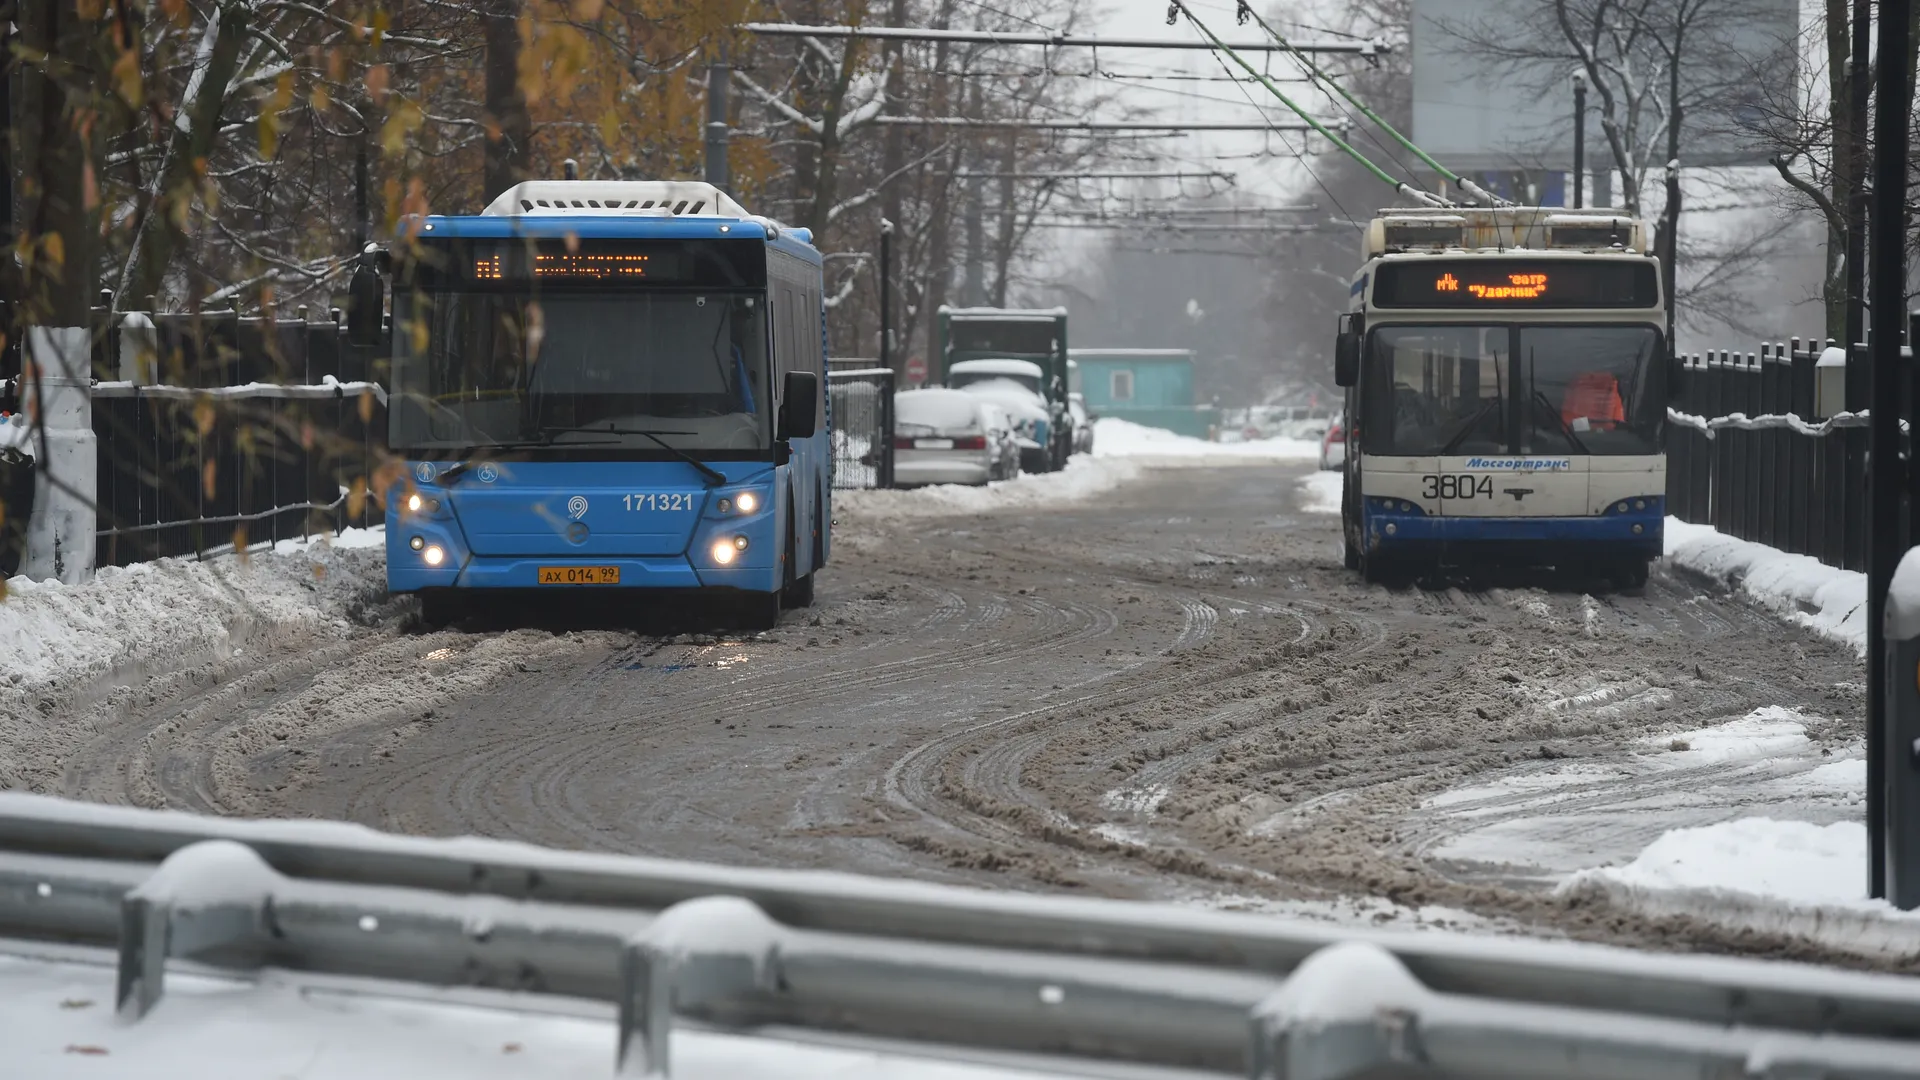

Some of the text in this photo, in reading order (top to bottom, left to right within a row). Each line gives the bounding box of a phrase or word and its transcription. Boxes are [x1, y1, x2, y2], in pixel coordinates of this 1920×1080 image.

[1509, 274, 1547, 285] еатр
[1467, 458, 1569, 470] Мосгортранс
[1422, 475, 1493, 500] 3804
[622, 493, 692, 511] 171321
[567, 568, 593, 582] 014
[601, 567, 615, 578] 99
